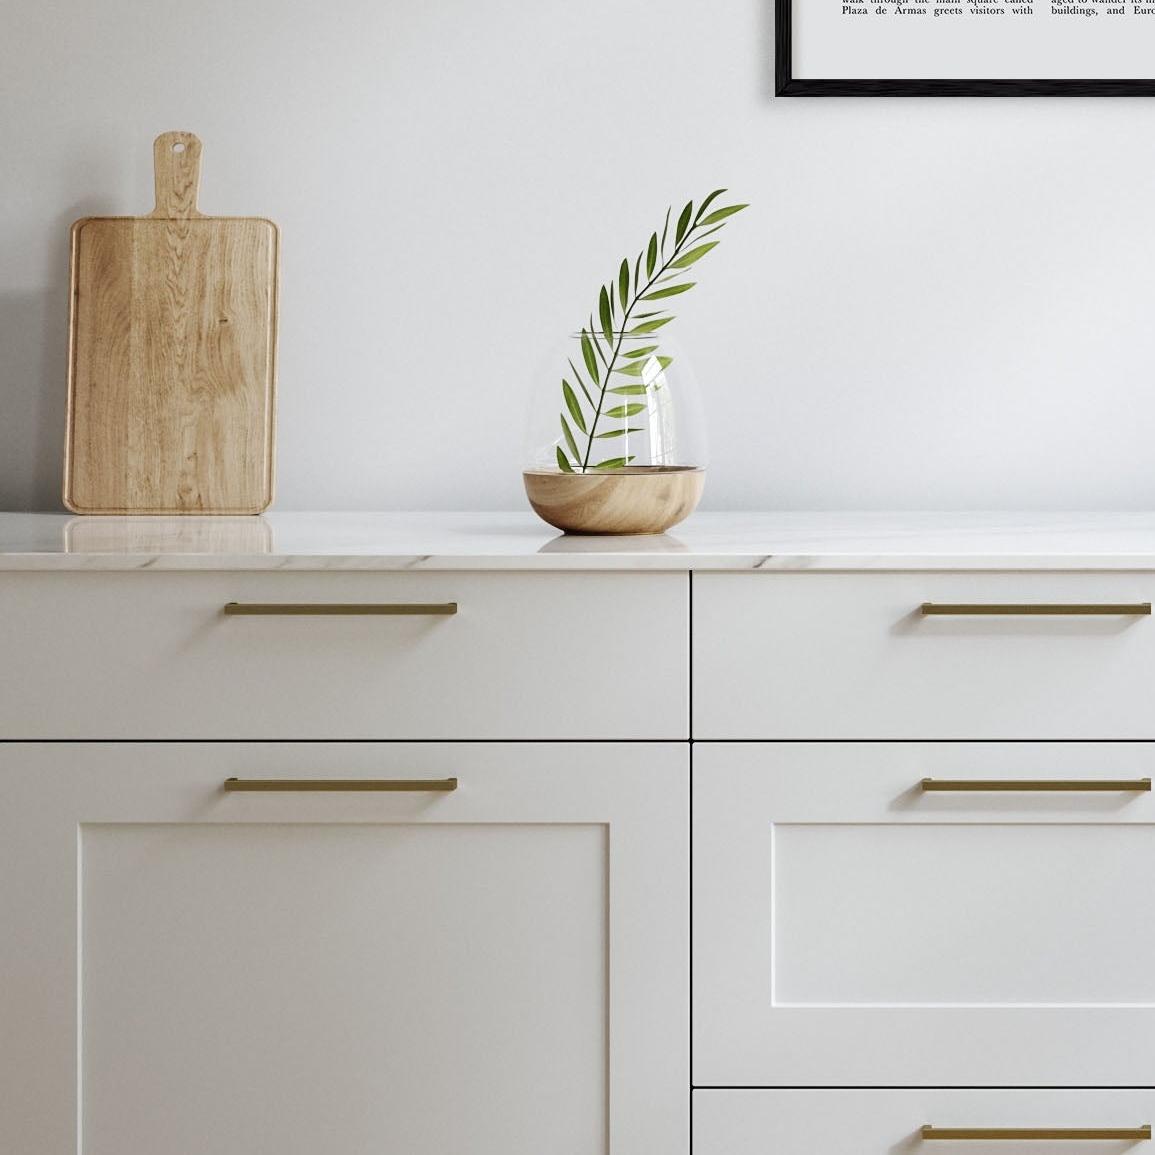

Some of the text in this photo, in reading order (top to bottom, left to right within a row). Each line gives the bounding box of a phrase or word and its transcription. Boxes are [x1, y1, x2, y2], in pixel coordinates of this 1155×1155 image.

[842, 5, 1033, 17] Plaza de Armas greets visitors with
[1051, 5, 1098, 17] buildings,
[1106, 6, 1125, 15] and
